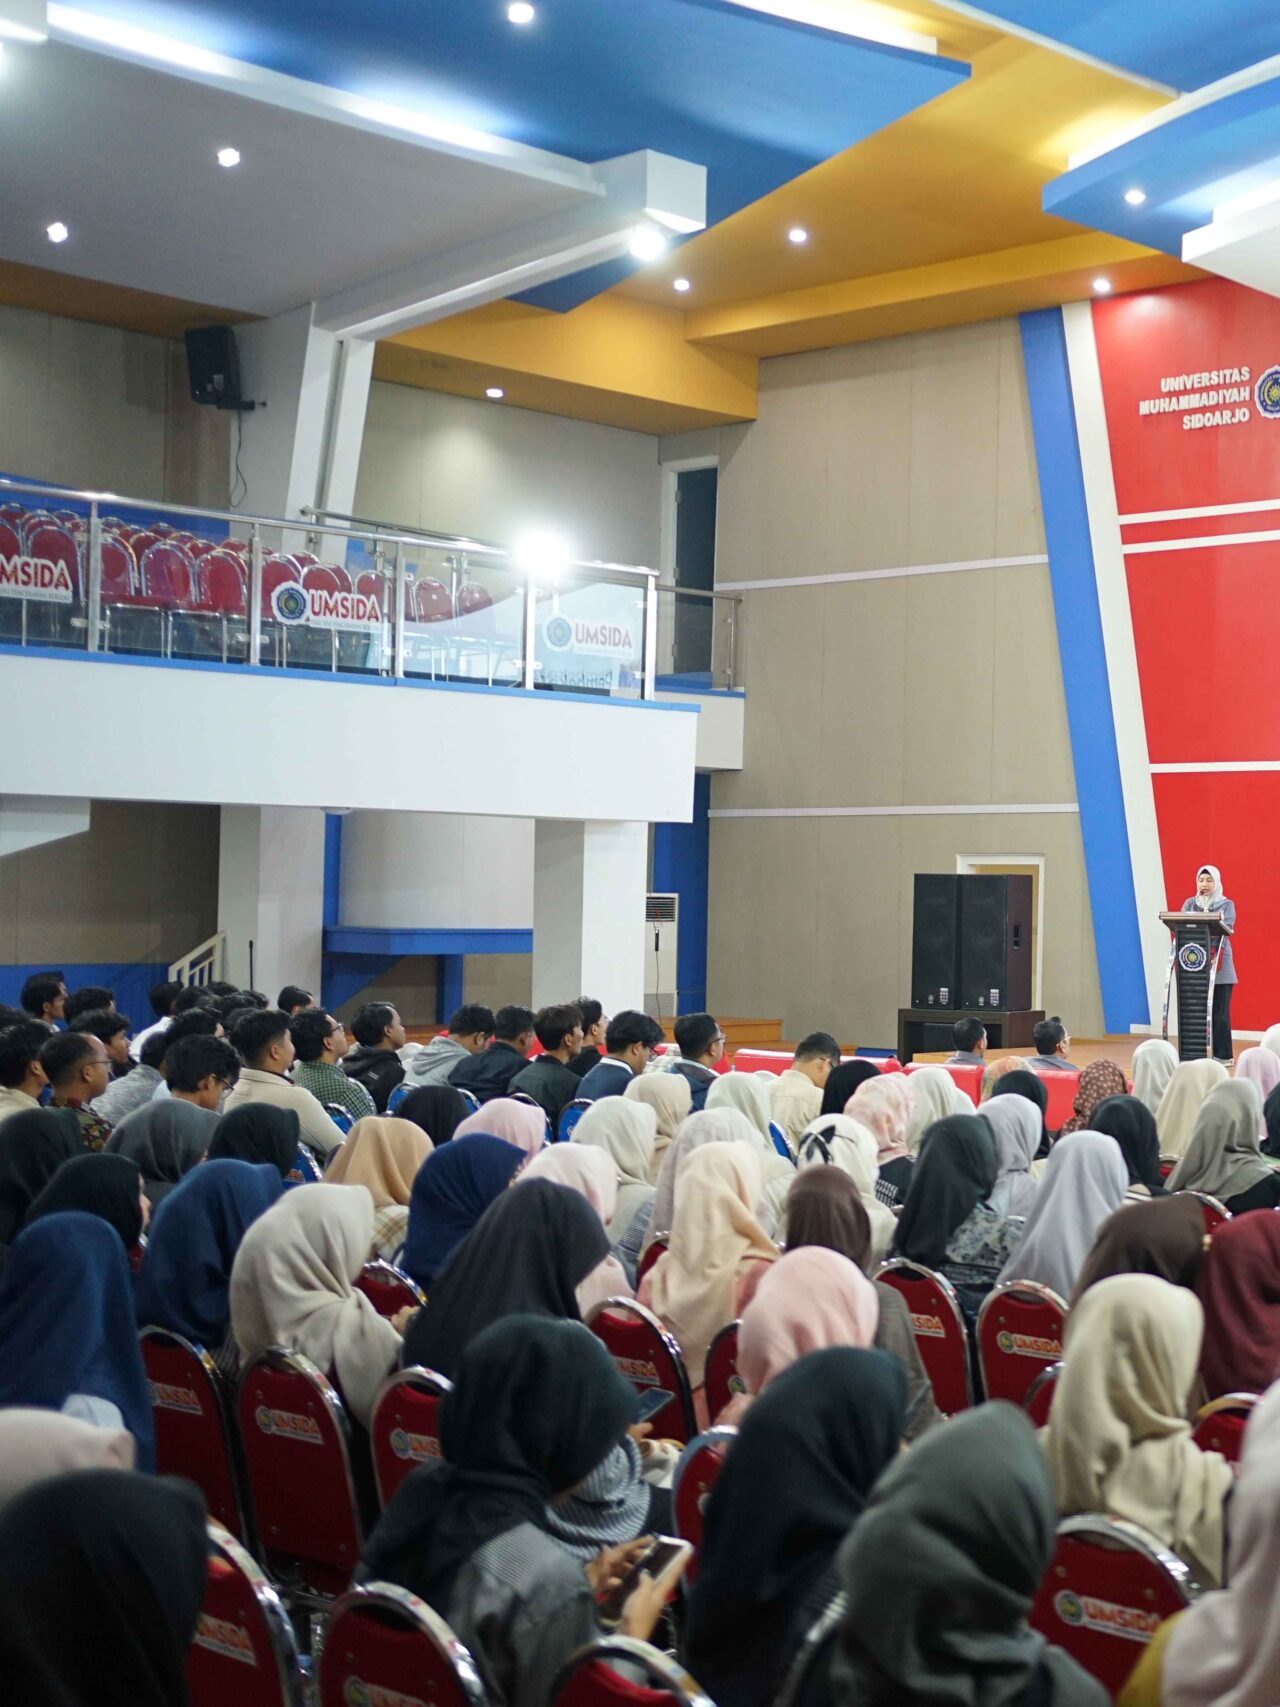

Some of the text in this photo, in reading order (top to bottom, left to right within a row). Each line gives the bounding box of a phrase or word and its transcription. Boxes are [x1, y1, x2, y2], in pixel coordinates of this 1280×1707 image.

[1160, 366, 1251, 392] UNIVERSITAS
[1139, 386, 1251, 415] MUHAMMADIYAH
[1183, 408, 1250, 430] SIDOARJO
[0, 560, 70, 591] MSIDA
[311, 590, 379, 622] UMSIDA
[575, 622, 632, 649] UMSIDA
[912, 1316, 943, 1330] SIDA
[1014, 1335, 1062, 1354] UMSIDA
